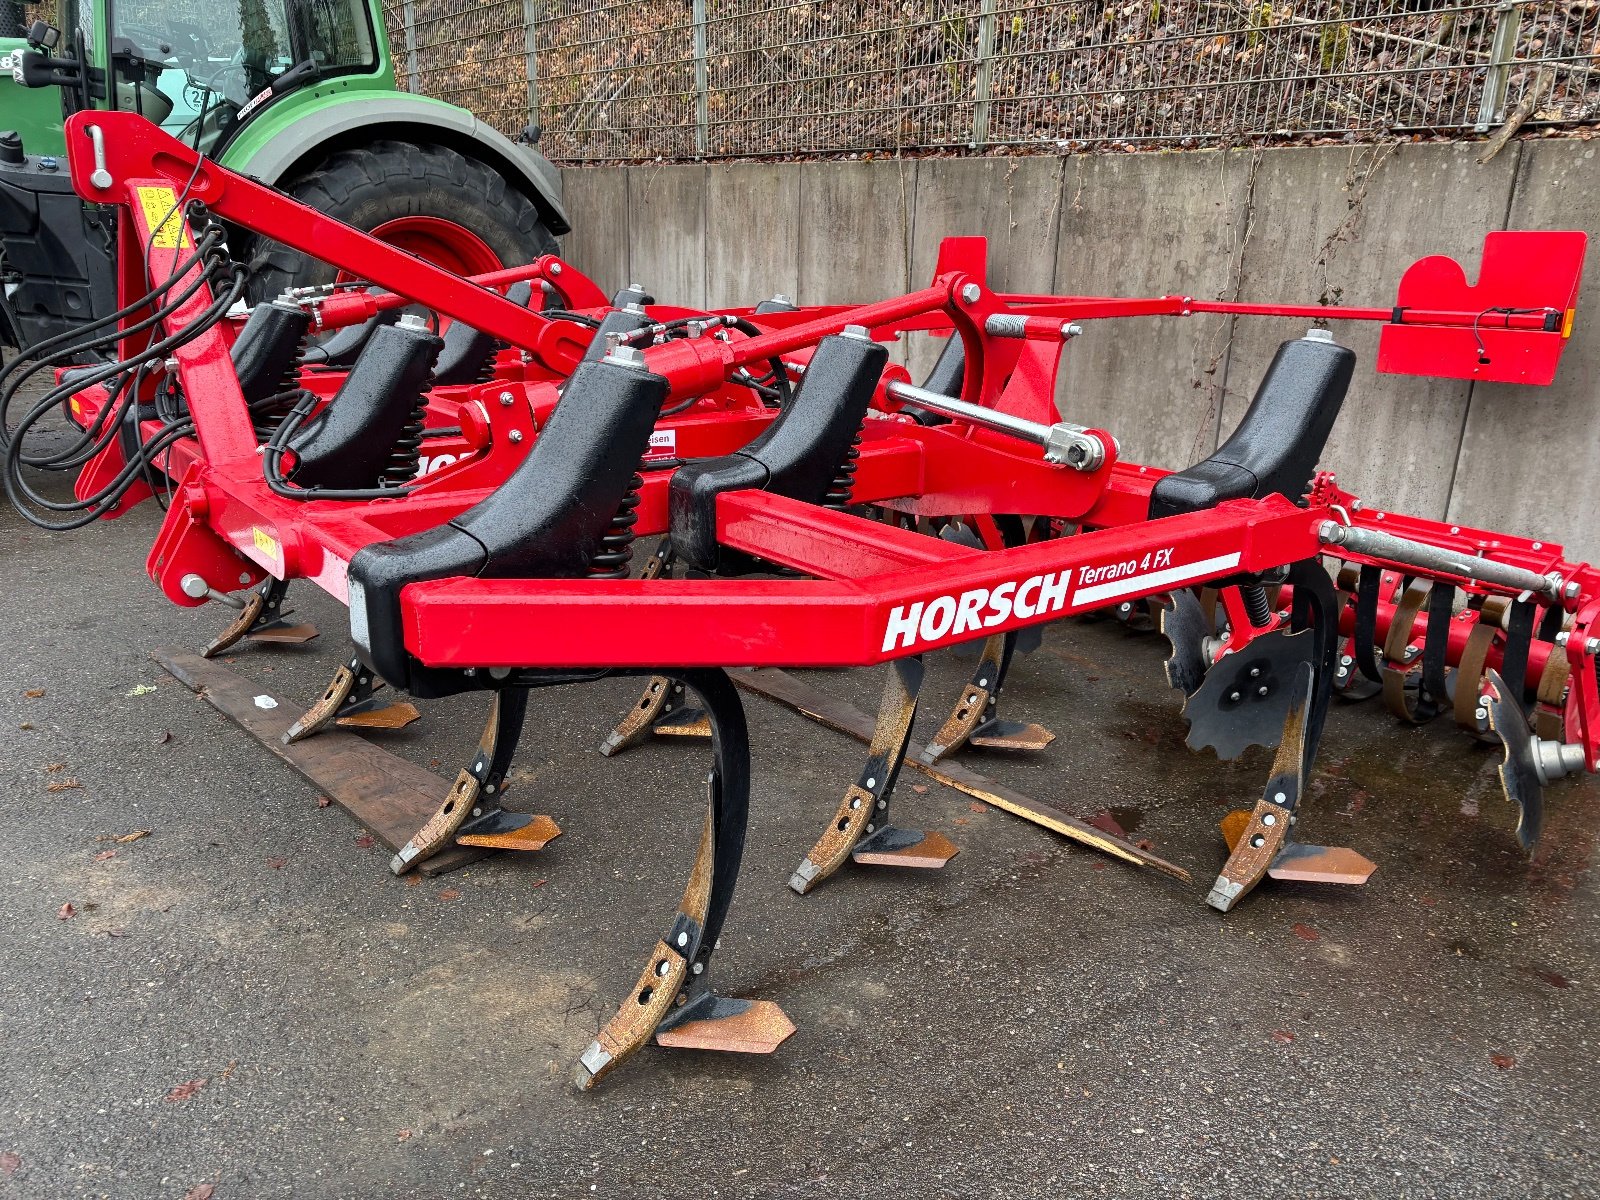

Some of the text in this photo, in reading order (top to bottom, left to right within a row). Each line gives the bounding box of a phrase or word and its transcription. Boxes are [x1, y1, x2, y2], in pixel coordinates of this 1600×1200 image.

[881, 547, 1175, 652] HORSCH Terrano 4 FX
